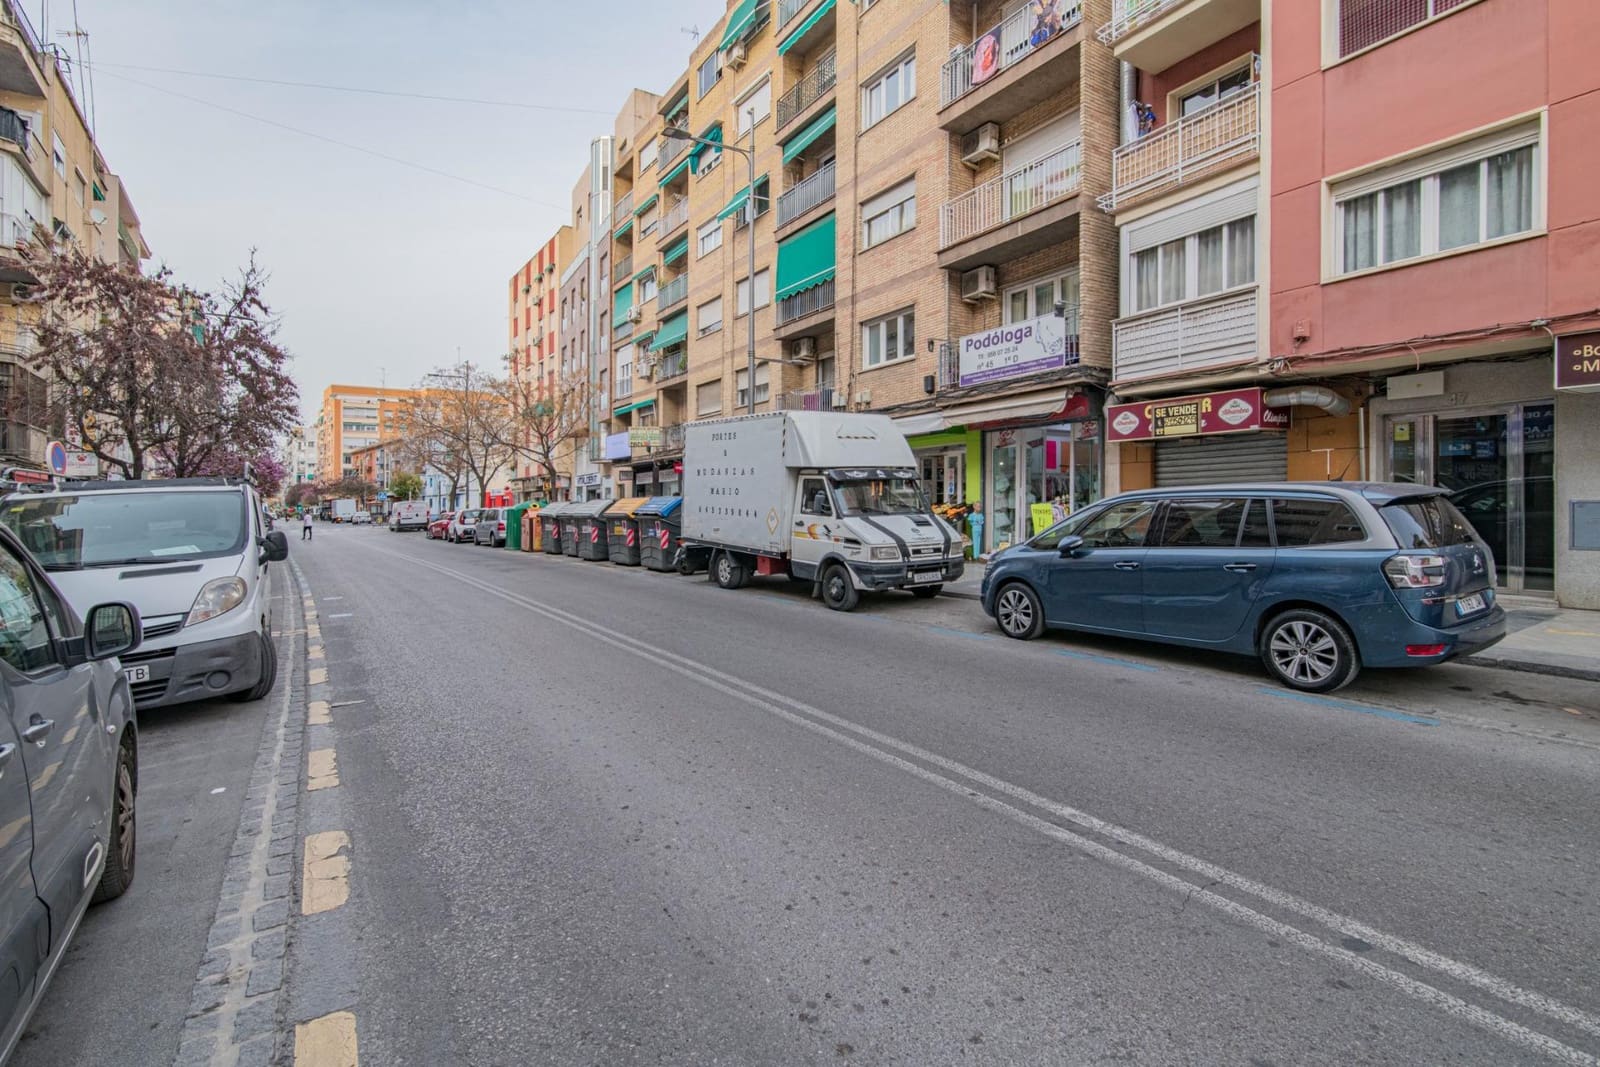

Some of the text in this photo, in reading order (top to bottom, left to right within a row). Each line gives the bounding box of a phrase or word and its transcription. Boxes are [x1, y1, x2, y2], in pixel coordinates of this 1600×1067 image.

[966, 326, 1032, 353] Podóloga
[1155, 408, 1167, 418] SE
[1168, 404, 1197, 417] VENDE
[712, 431, 737, 441] PORTES
[710, 487, 740, 496] MARIO
